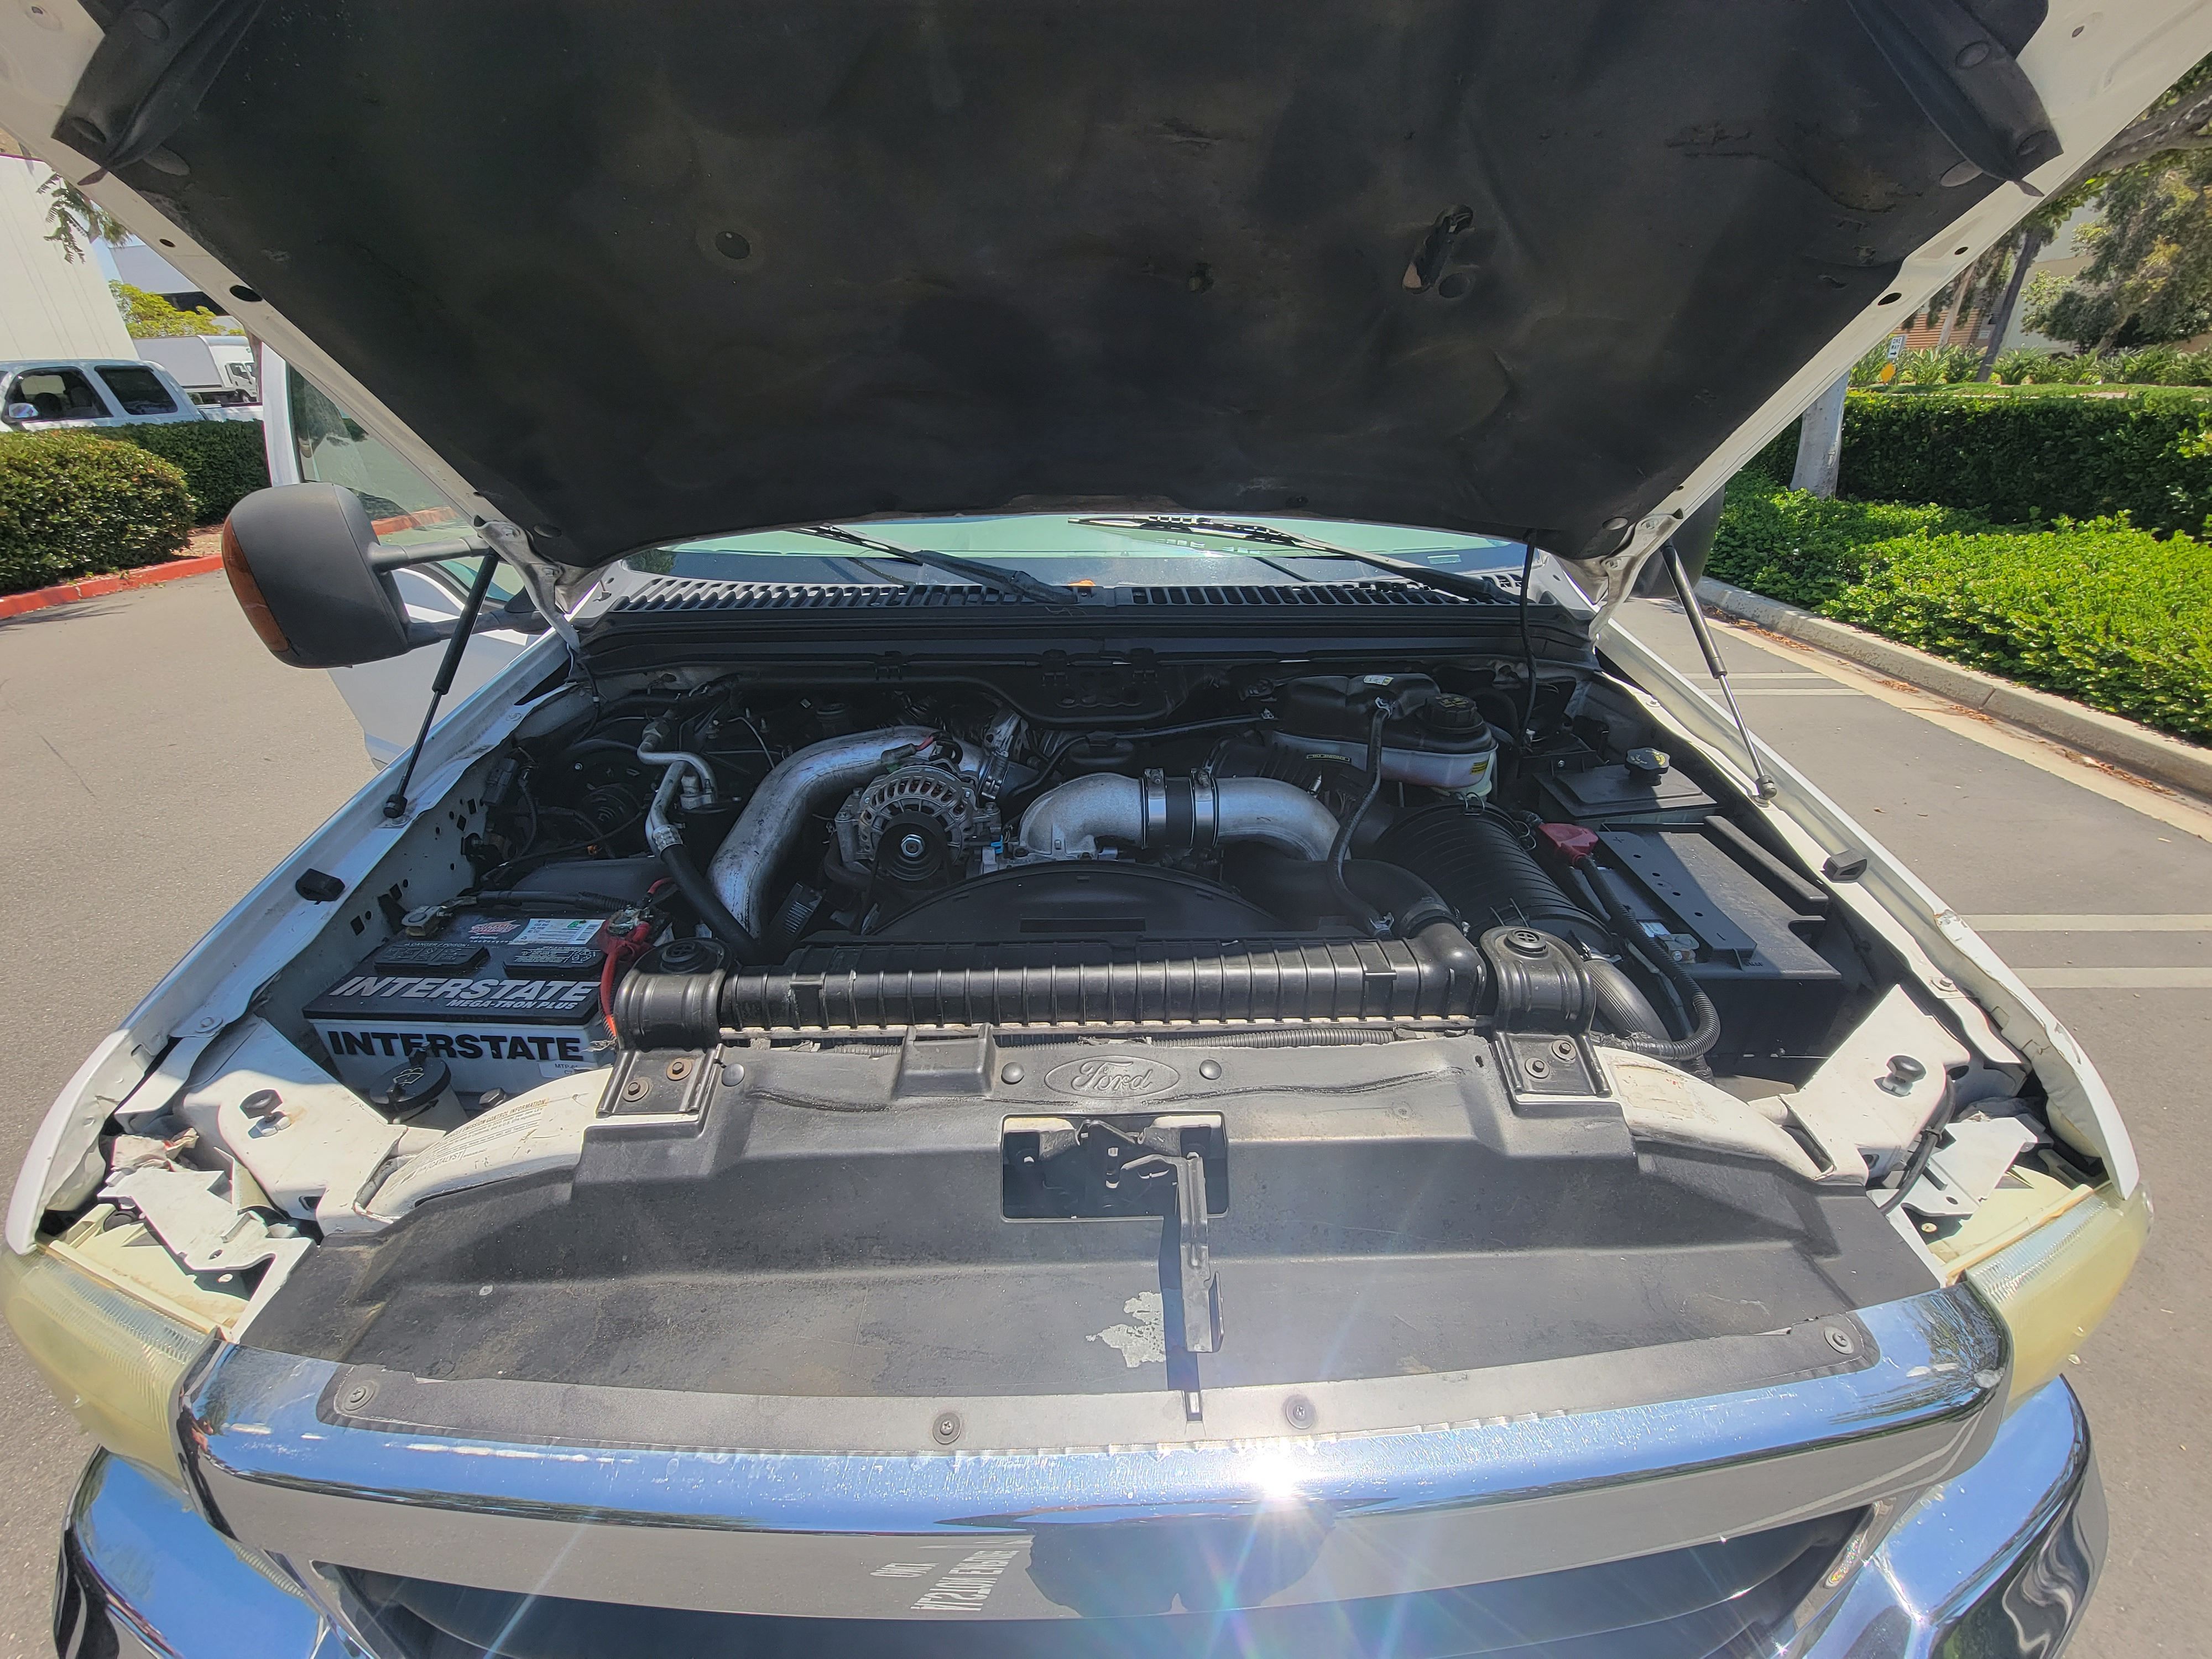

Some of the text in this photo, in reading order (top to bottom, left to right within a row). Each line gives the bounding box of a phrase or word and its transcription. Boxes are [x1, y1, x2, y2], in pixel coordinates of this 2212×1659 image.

[328, 976, 602, 1001] INTERSTATE
[445, 999, 579, 1010] MEGA-TRON PLUS
[327, 1031, 584, 1061] INTERSTATE
[1071, 1060, 1154, 1092] Ford
[509, 1098, 546, 1114] INFORMATION
